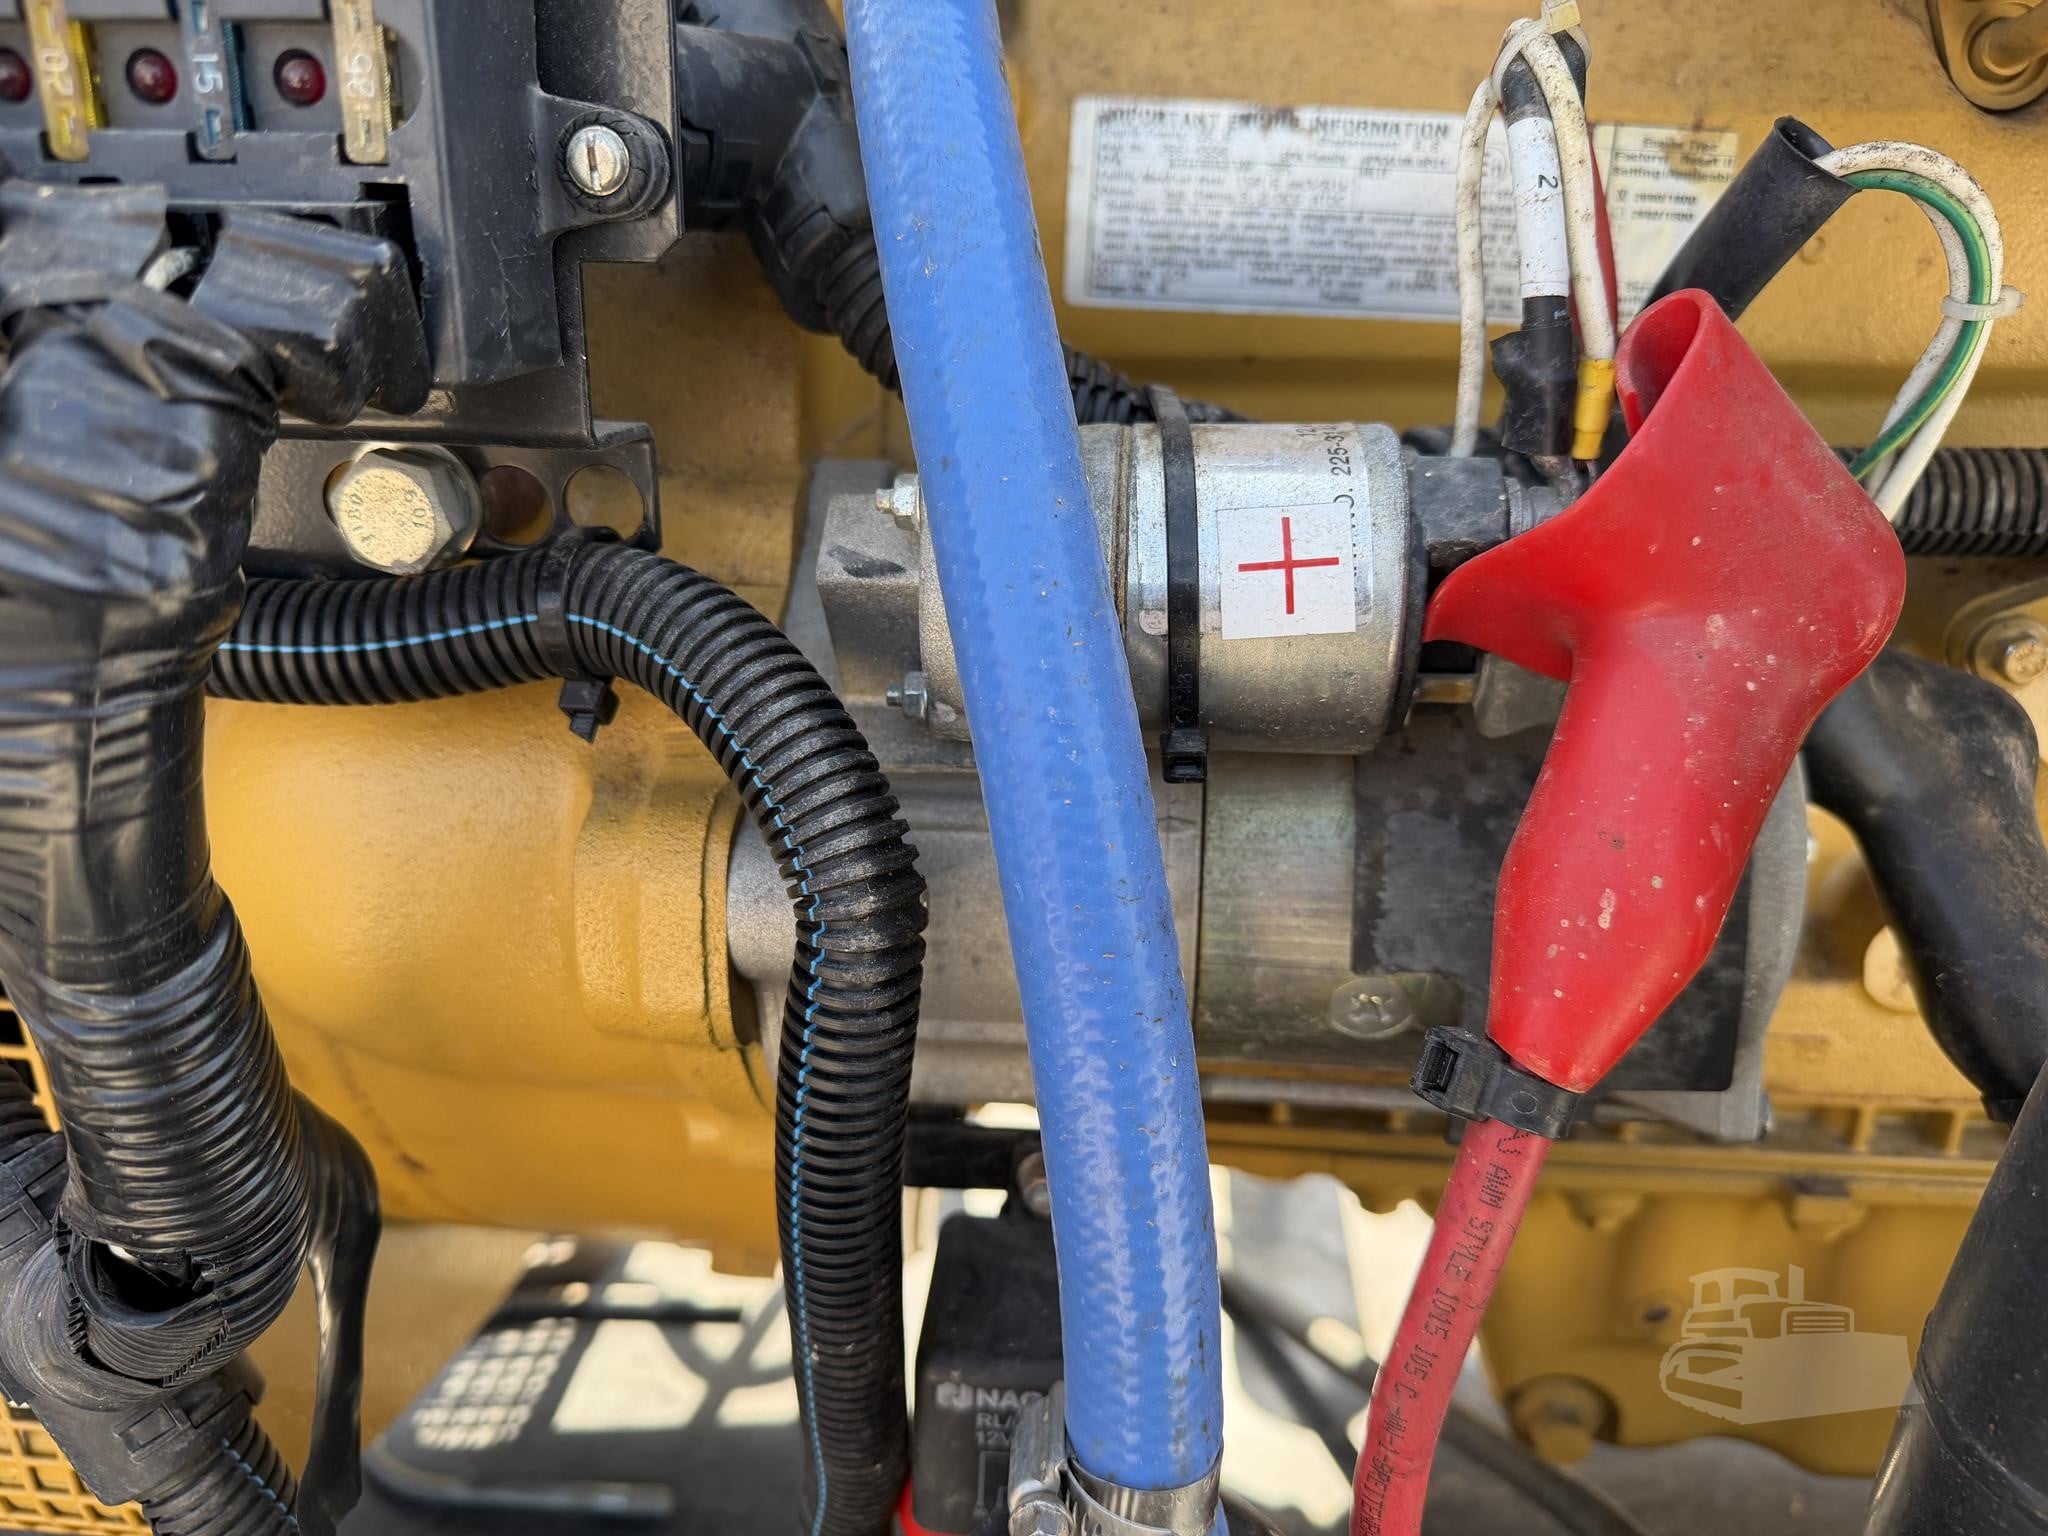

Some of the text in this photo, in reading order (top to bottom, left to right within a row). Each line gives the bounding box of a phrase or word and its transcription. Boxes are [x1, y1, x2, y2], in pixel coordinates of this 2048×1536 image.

[191, 53, 223, 94] 15
[344, 53, 376, 98] 25
[1538, 174, 1559, 189] 2
[1479, 1162, 1512, 1209] AWM
[1444, 1216, 1494, 1282] STYLE
[1403, 1343, 1439, 1380] 105
